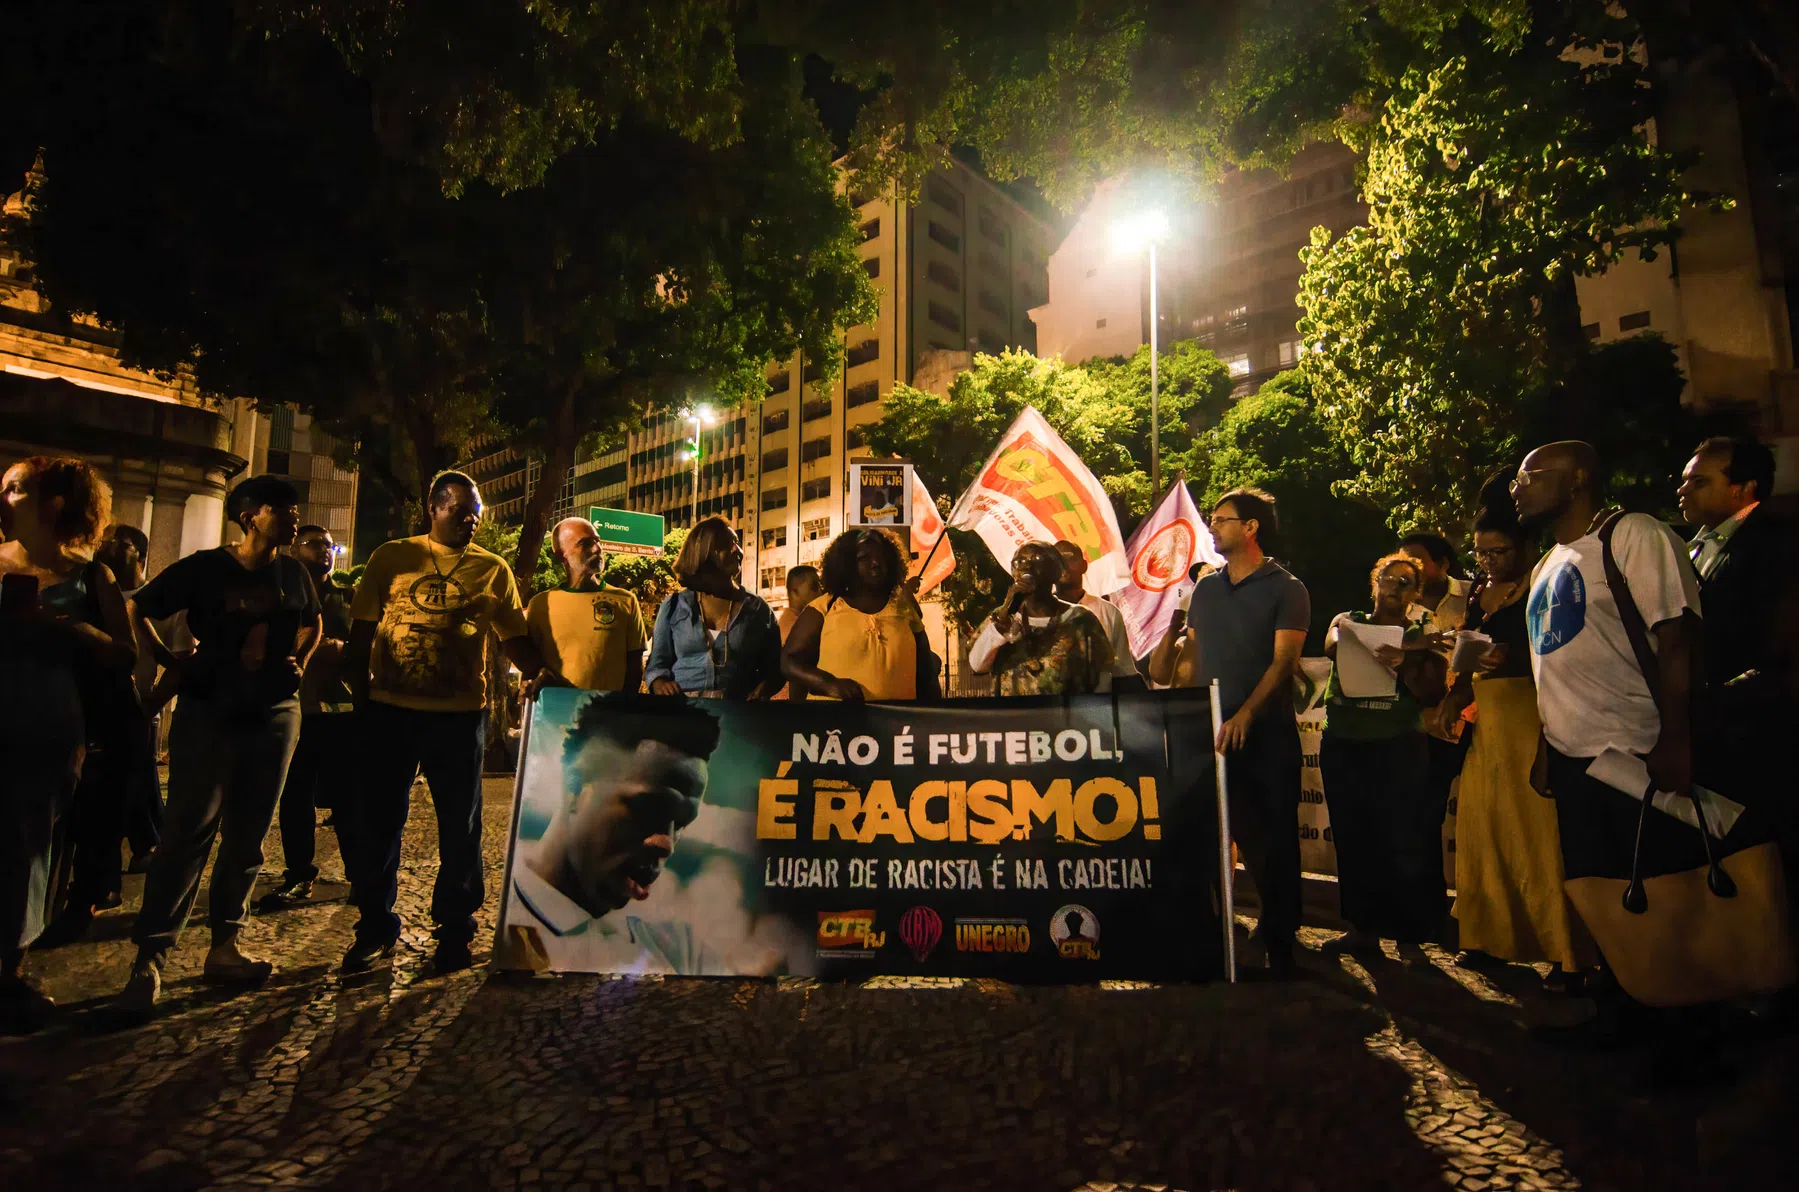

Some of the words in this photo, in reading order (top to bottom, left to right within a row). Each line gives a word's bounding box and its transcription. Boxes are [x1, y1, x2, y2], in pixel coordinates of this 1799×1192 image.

[604, 522, 630, 532] Retorno
[638, 547, 654, 555] Bento
[791, 728, 880, 766] NÃO
[893, 725, 915, 765] É
[928, 728, 1124, 766] FUTEBOL,
[756, 760, 799, 840] É
[812, 776, 1162, 845] RACISMO!
[764, 856, 840, 889] LUGAR
[848, 857, 879, 889] DE
[887, 858, 983, 890] RACISTA
[991, 853, 1006, 890] É
[1015, 858, 1049, 890] NA
[1057, 858, 1152, 890] CADEIA!
[955, 924, 1031, 953] UNEGRO
